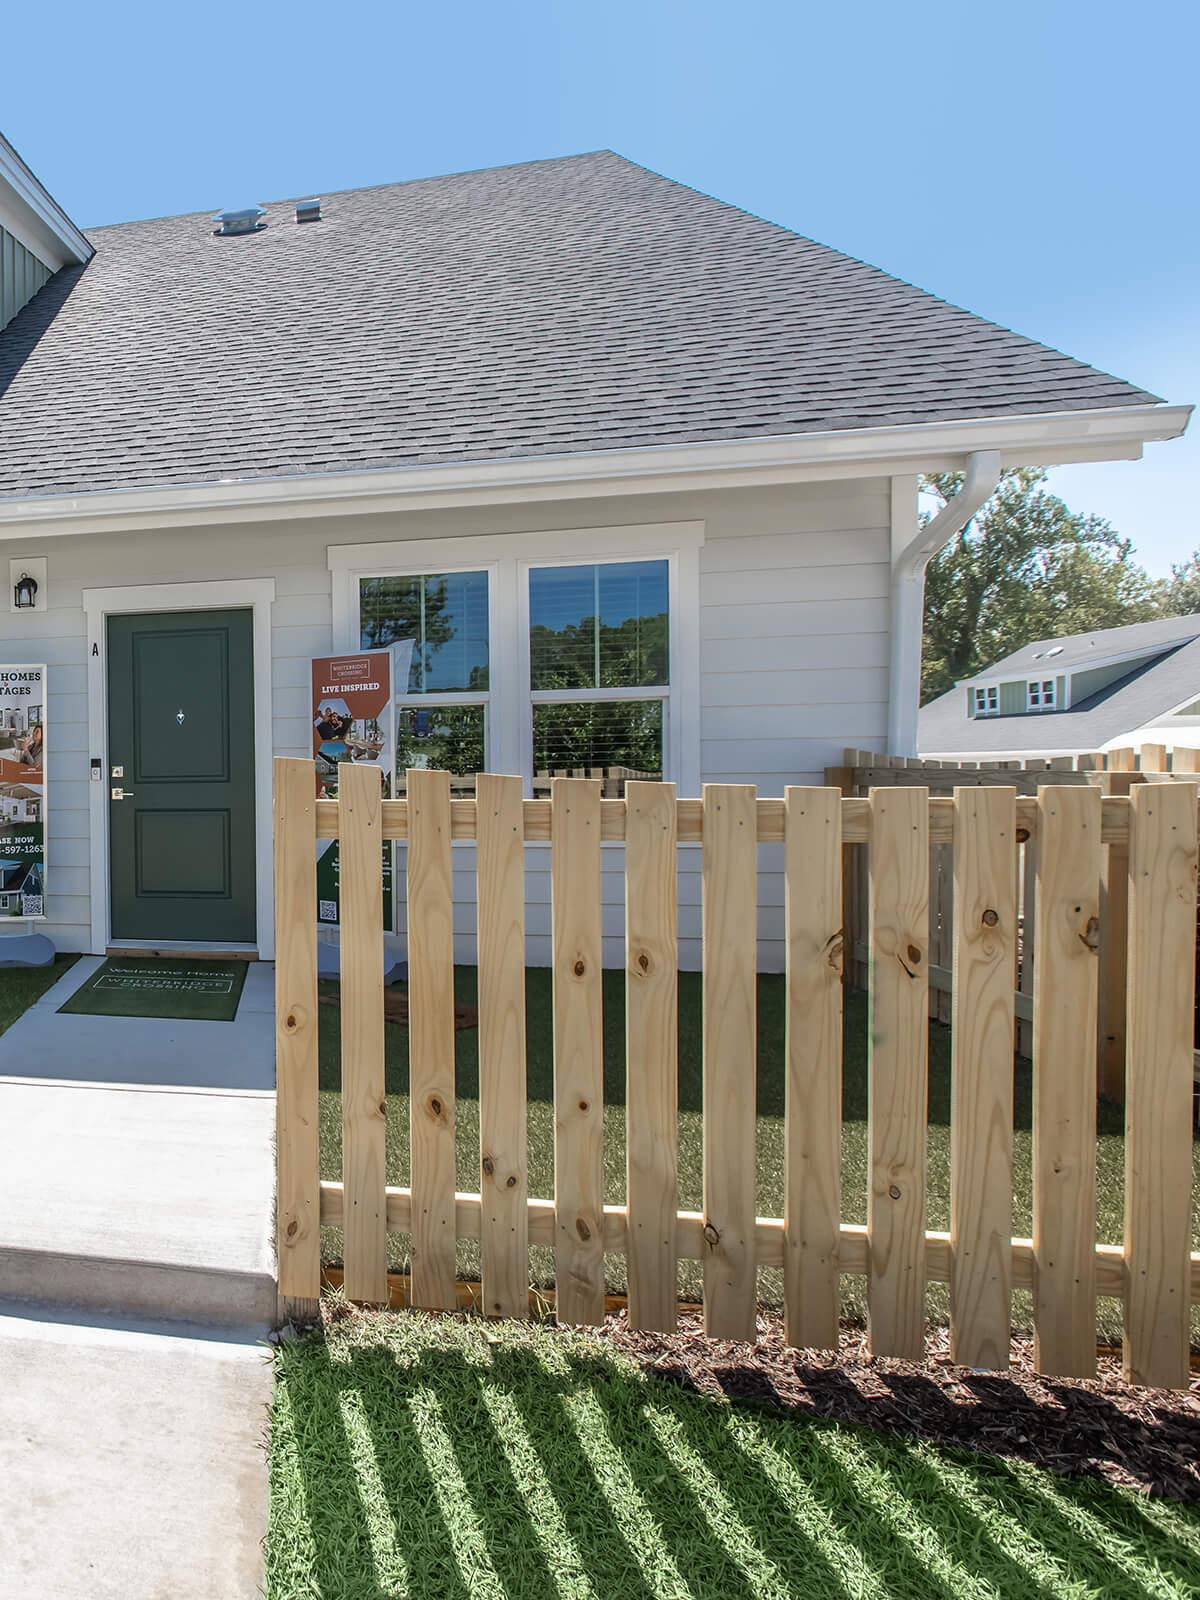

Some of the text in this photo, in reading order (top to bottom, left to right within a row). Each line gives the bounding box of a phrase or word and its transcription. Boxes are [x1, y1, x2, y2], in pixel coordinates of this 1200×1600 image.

[92, 642, 99, 657] A
[321, 682, 380, 694] LIVE INSPIRED
[14, 836, 35, 844] NOW
[109, 967, 183, 975] Welcome
